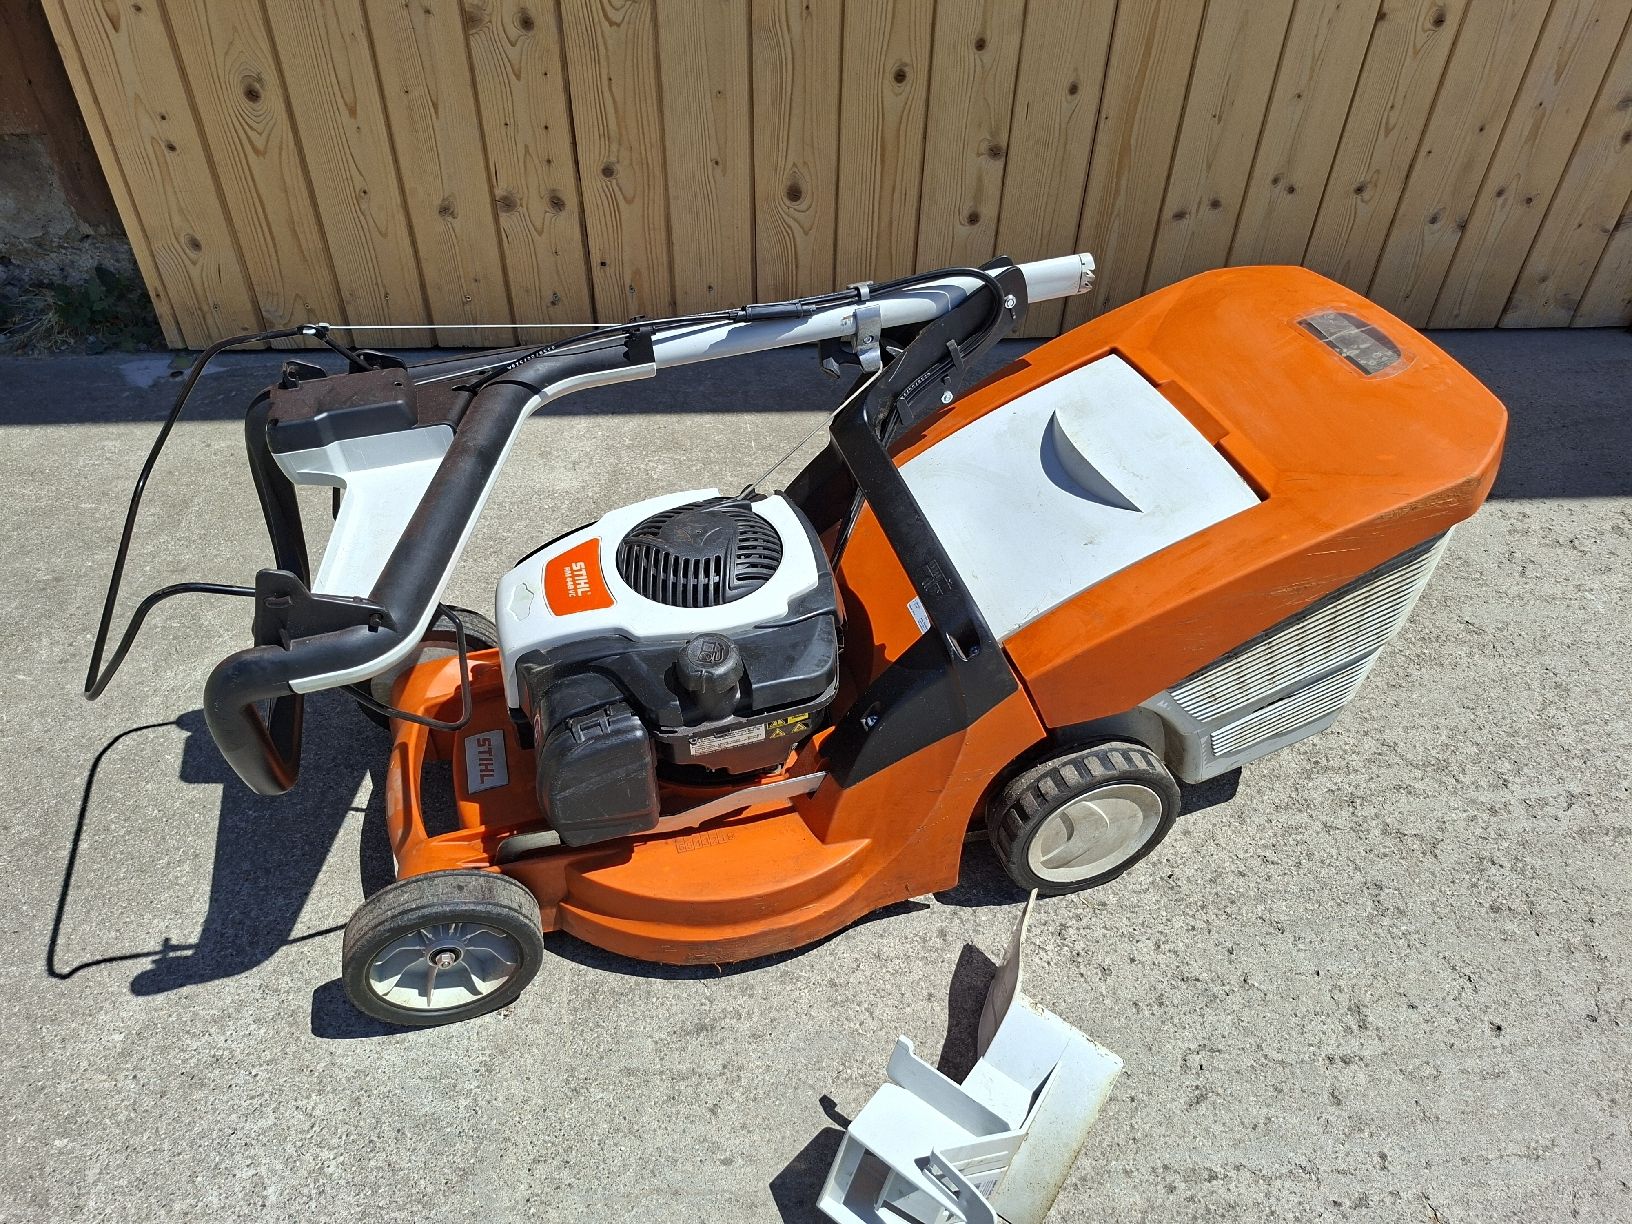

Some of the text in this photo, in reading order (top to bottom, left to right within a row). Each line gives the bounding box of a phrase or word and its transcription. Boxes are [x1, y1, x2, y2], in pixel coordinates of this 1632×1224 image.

[563, 566, 572, 577] RM
[571, 561, 591, 597] STIHL
[476, 737, 495, 784] STIHL
